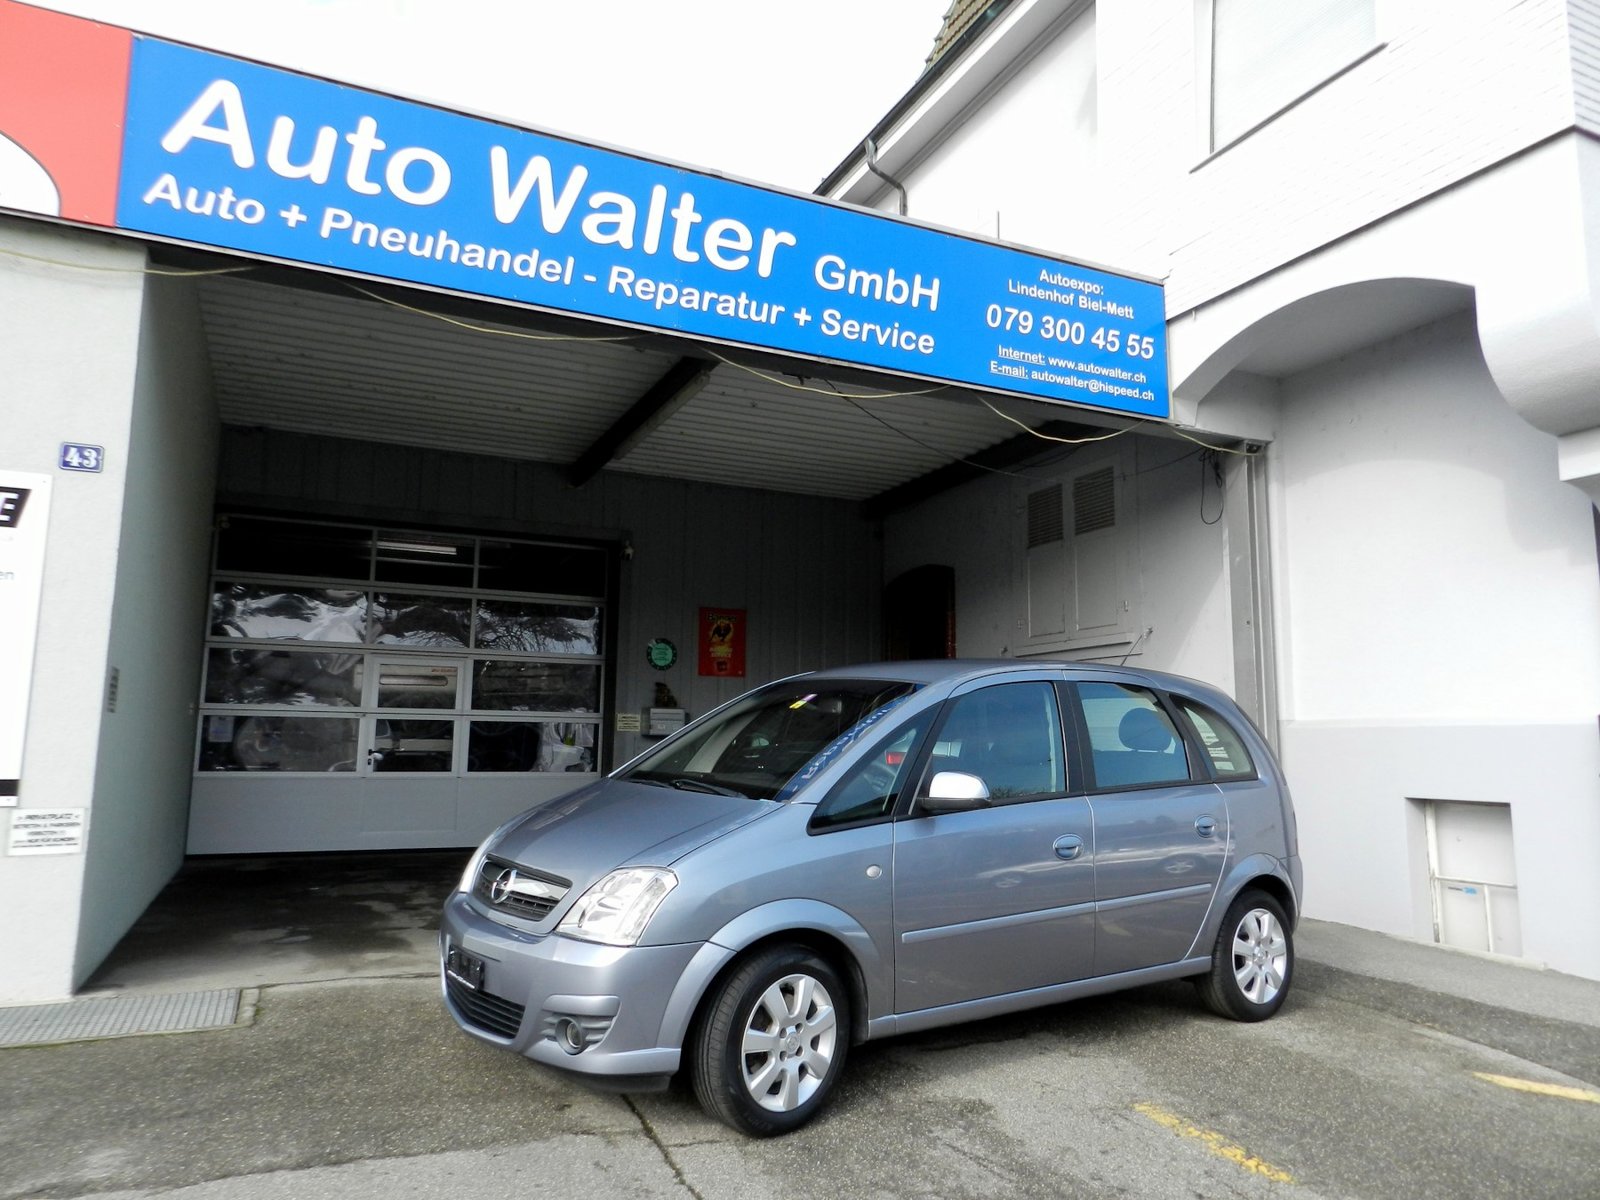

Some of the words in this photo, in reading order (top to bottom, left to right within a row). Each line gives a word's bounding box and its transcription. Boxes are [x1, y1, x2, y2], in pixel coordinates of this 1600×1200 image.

[159, 78, 452, 206] Auto
[489, 144, 797, 278] Walter
[814, 254, 940, 312] GmbH
[141, 172, 266, 225] Auto
[278, 203, 308, 228] +
[319, 206, 575, 285] Pneuhandel
[607, 265, 786, 325] Reparatur
[793, 307, 812, 327] +
[820, 308, 935, 355] Service
[1039, 269, 1104, 295] Autoexpo:
[1008, 279, 1075, 306] Lindenhof
[1078, 294, 1135, 320] Biel-Mett
[986, 303, 1034, 335] 079
[1039, 315, 1086, 345] 300
[1090, 326, 1121, 353] 45
[1126, 333, 1155, 360] 55
[989, 360, 1029, 380] E-mail:
[1030, 370, 1155, 401] autowalter@hispeed.ch
[997, 344, 1046, 366] Internet:
[1047, 356, 1147, 384] www.autowalter.ch
[65, 446, 98, 468] 43
